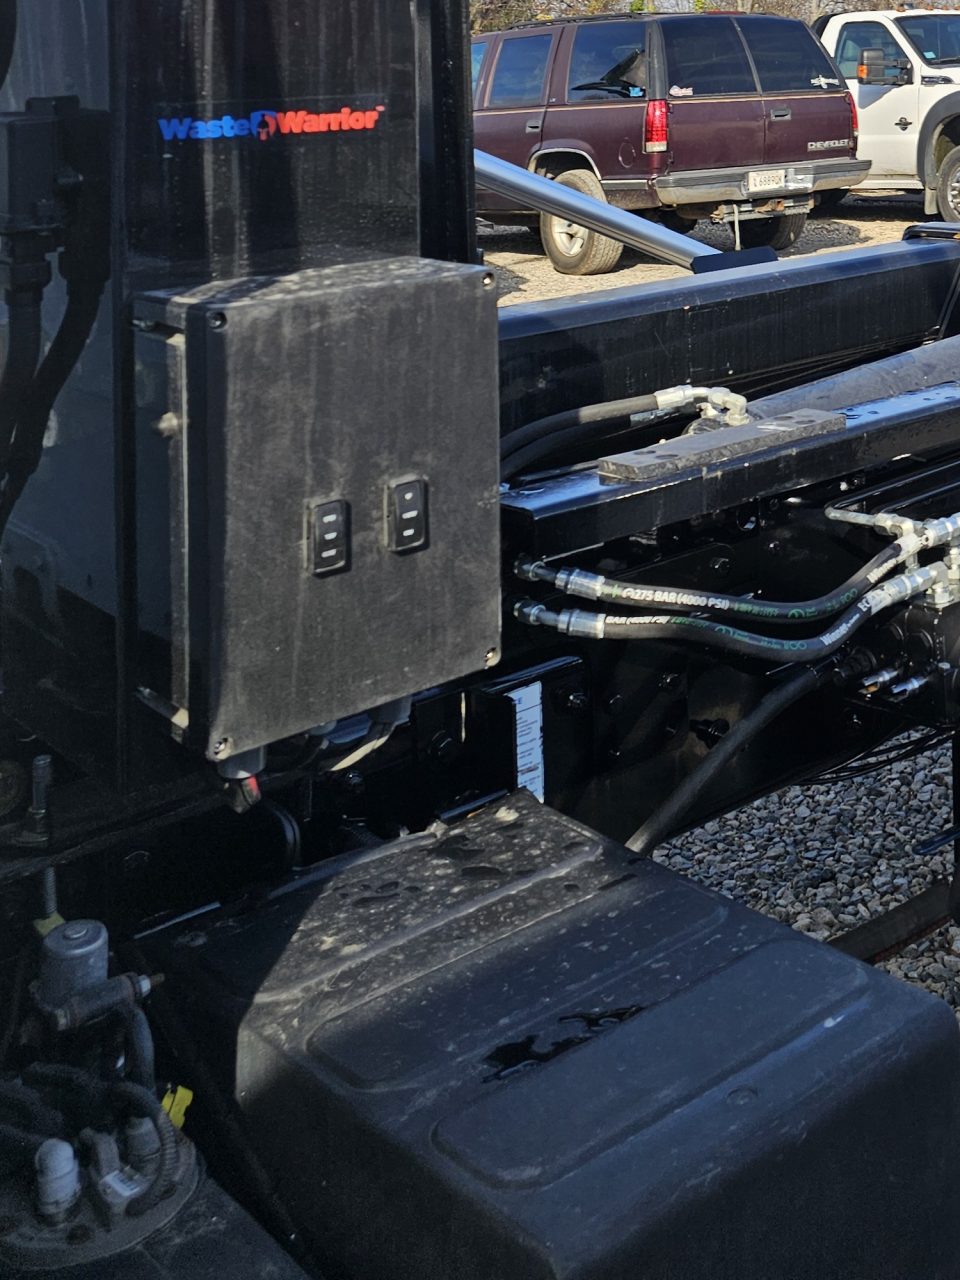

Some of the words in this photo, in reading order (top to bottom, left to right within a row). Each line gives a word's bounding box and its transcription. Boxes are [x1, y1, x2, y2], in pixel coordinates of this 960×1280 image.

[158, 115, 250, 140] Waste
[277, 107, 379, 134] Warrior
[807, 138, 850, 150] CHEVROLET
